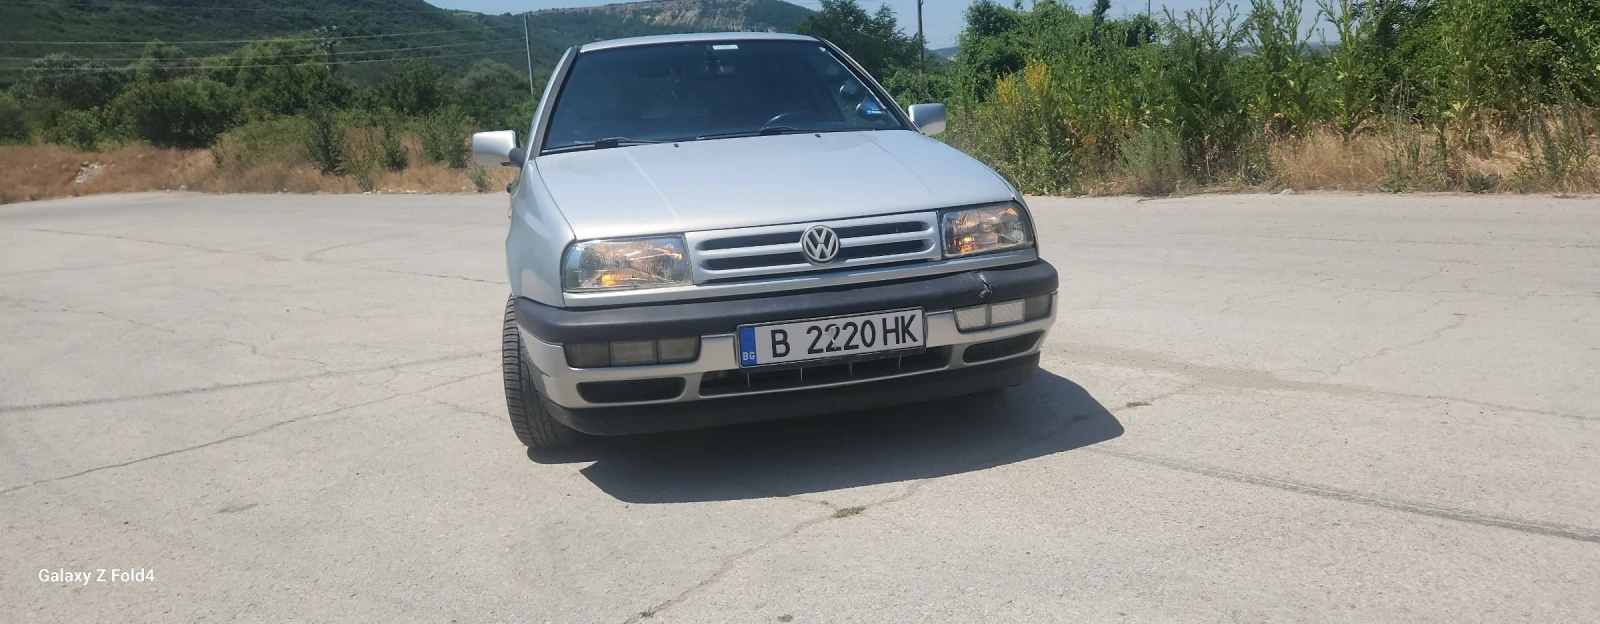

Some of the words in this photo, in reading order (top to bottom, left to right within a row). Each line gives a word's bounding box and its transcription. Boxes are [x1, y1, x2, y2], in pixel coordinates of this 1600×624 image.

[803, 226, 838, 261] VW
[770, 329, 791, 358] B
[806, 319, 876, 355] 2220
[882, 314, 918, 346] HK
[742, 351, 756, 361] BG
